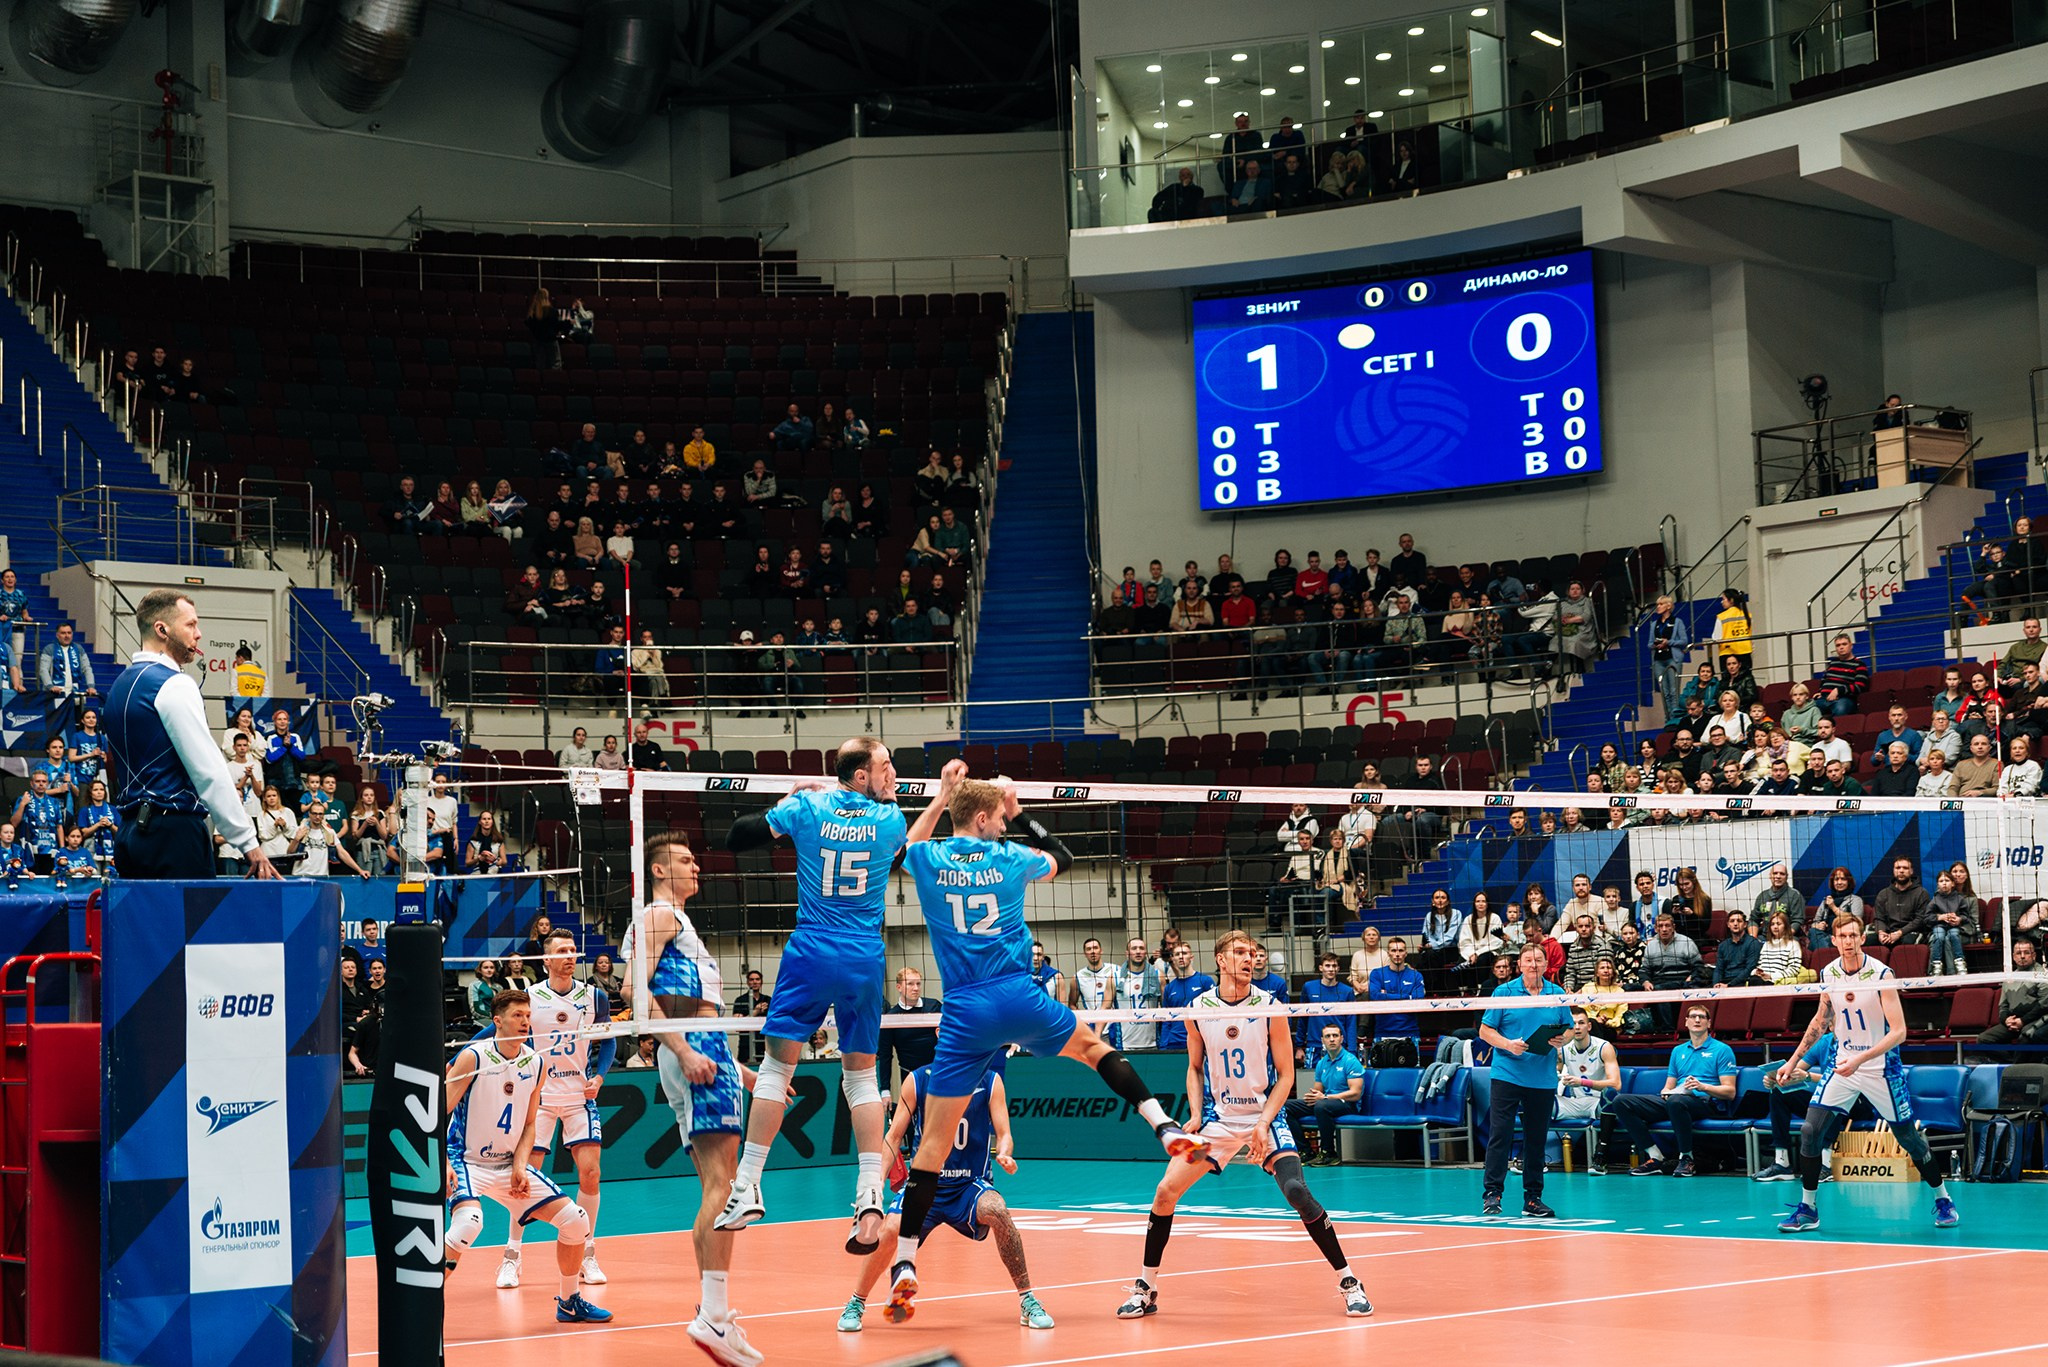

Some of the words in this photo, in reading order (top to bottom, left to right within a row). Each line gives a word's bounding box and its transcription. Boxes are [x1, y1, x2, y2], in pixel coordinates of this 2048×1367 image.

[1463, 263, 1569, 292] ДИНАМО-ЛО
[1364, 287, 1385, 307] 0
[1407, 282, 1428, 302] 0
[1246, 300, 1301, 316] ЗЕНИТ
[1505, 312, 1552, 362] 0
[1246, 343, 1279, 391] 1
[1363, 353, 1417, 375] СЕТ
[1520, 393, 1544, 417] Т
[1562, 387, 1584, 411] 0
[1212, 426, 1235, 449] 0
[1254, 422, 1280, 445] Т
[1563, 416, 1586, 440] 0
[1213, 454, 1237, 477] 0
[1525, 451, 1549, 475] В
[1564, 446, 1588, 470] 0
[1214, 481, 1238, 505] 0
[1257, 479, 1282, 502] В
[1859, 585, 1876, 600] С5
[1881, 582, 1899, 598] С6
[210, 640, 235, 649] Партер
[209, 658, 227, 672] С4
[1346, 692, 1407, 726] С5
[708, 779, 747, 790] PARI
[1056, 787, 1088, 798] PARI
[1210, 791, 1240, 801] PARI
[1354, 793, 1381, 803] PARI
[1486, 796, 1514, 806] PARI
[1611, 797, 1637, 807] PARI
[1728, 799, 1751, 809] PARI
[1838, 800, 1860, 809] PARI
[1942, 801, 1962, 810] PARI
[820, 821, 876, 842] ИВОВИЧ
[819, 848, 870, 897] 15
[936, 867, 1004, 887] ДОВГАНЬ
[402, 905, 419, 913] FIVB
[945, 893, 1002, 936] 12
[220, 993, 274, 1018] ВФВ
[1130, 993, 1147, 1009] 12
[1842, 1008, 1866, 1031] 11
[549, 1030, 576, 1056] 23
[1220, 1048, 1246, 1078] 13
[1008, 1097, 1118, 1118] БУКМЕКЕР
[496, 1103, 513, 1135] 4
[389, 1062, 444, 1288] PARI
[1842, 1165, 1895, 1177] DARPOL
[225, 1219, 280, 1239] ГАЗПРОМ
[202, 1242, 249, 1254] ГЕНЕРАЛЬНЫЙ
[250, 1240, 281, 1250] СПОНСОР
